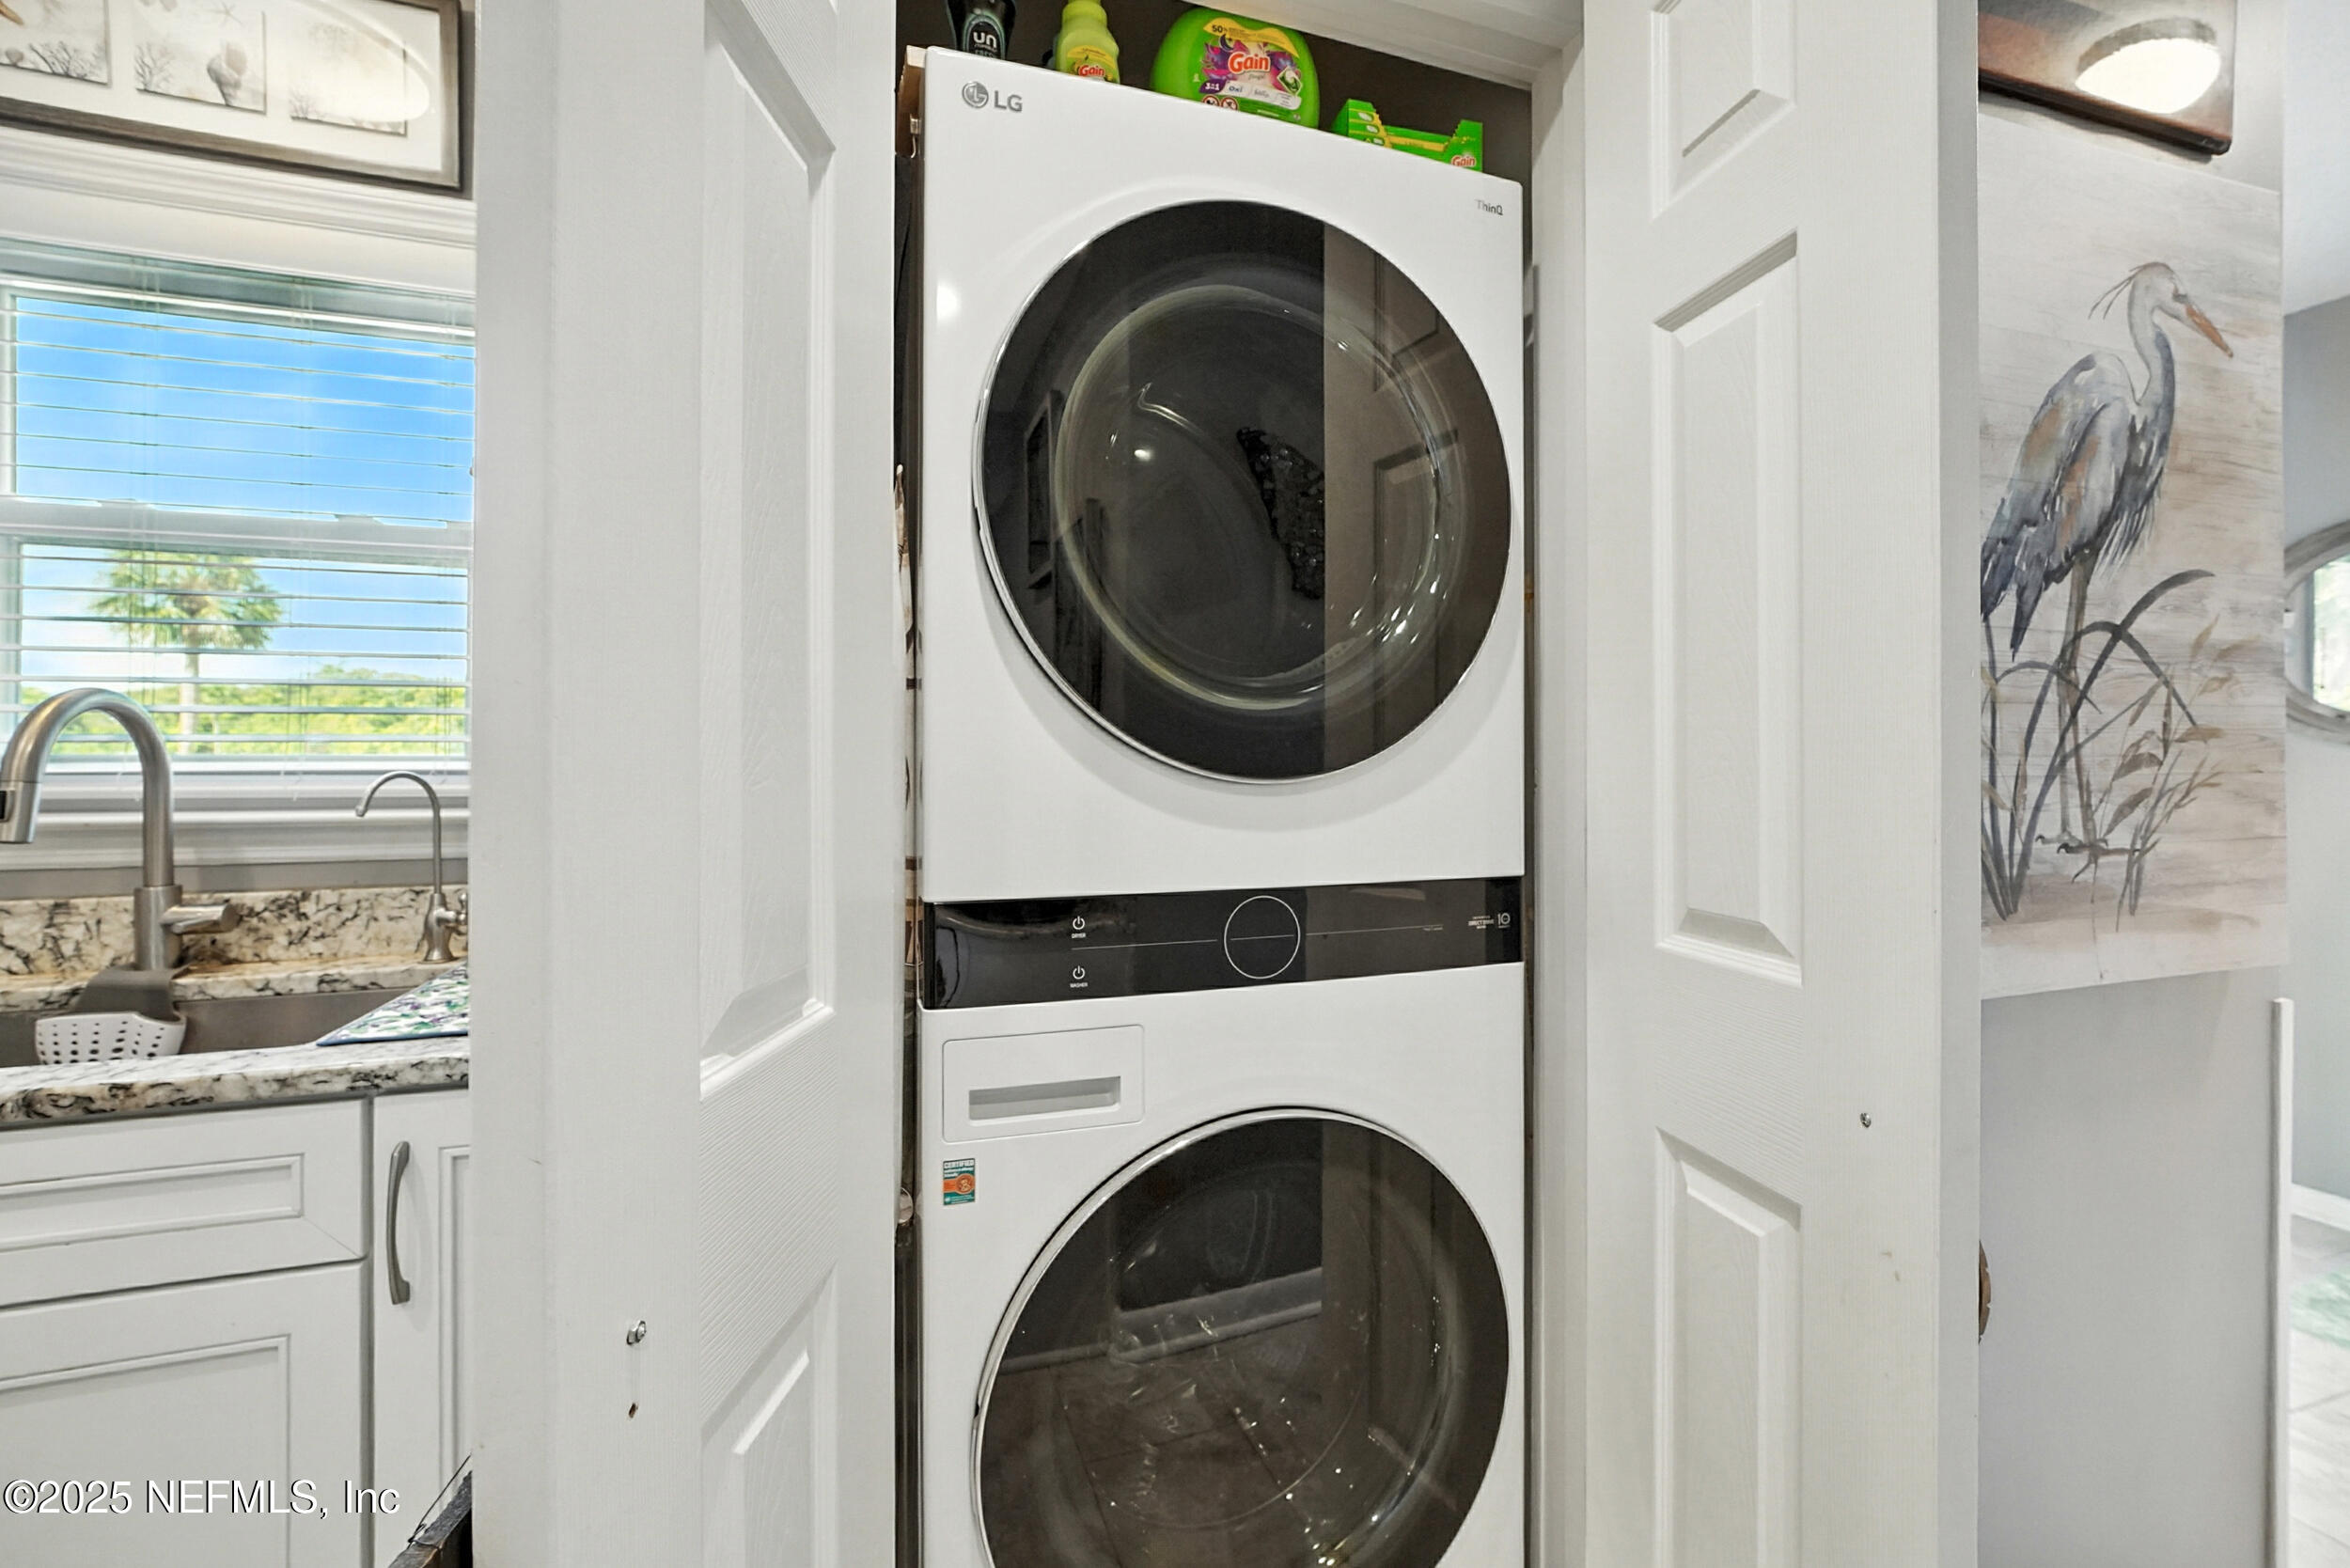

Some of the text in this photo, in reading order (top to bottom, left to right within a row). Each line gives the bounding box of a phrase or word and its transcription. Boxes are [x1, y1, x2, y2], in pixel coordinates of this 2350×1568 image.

[1078, 64, 1105, 77] Gain
[1228, 51, 1271, 74] Gain
[995, 90, 1023, 112] LG
[1451, 154, 1477, 167] Gain
[1474, 199, 1503, 216] ThinQ
